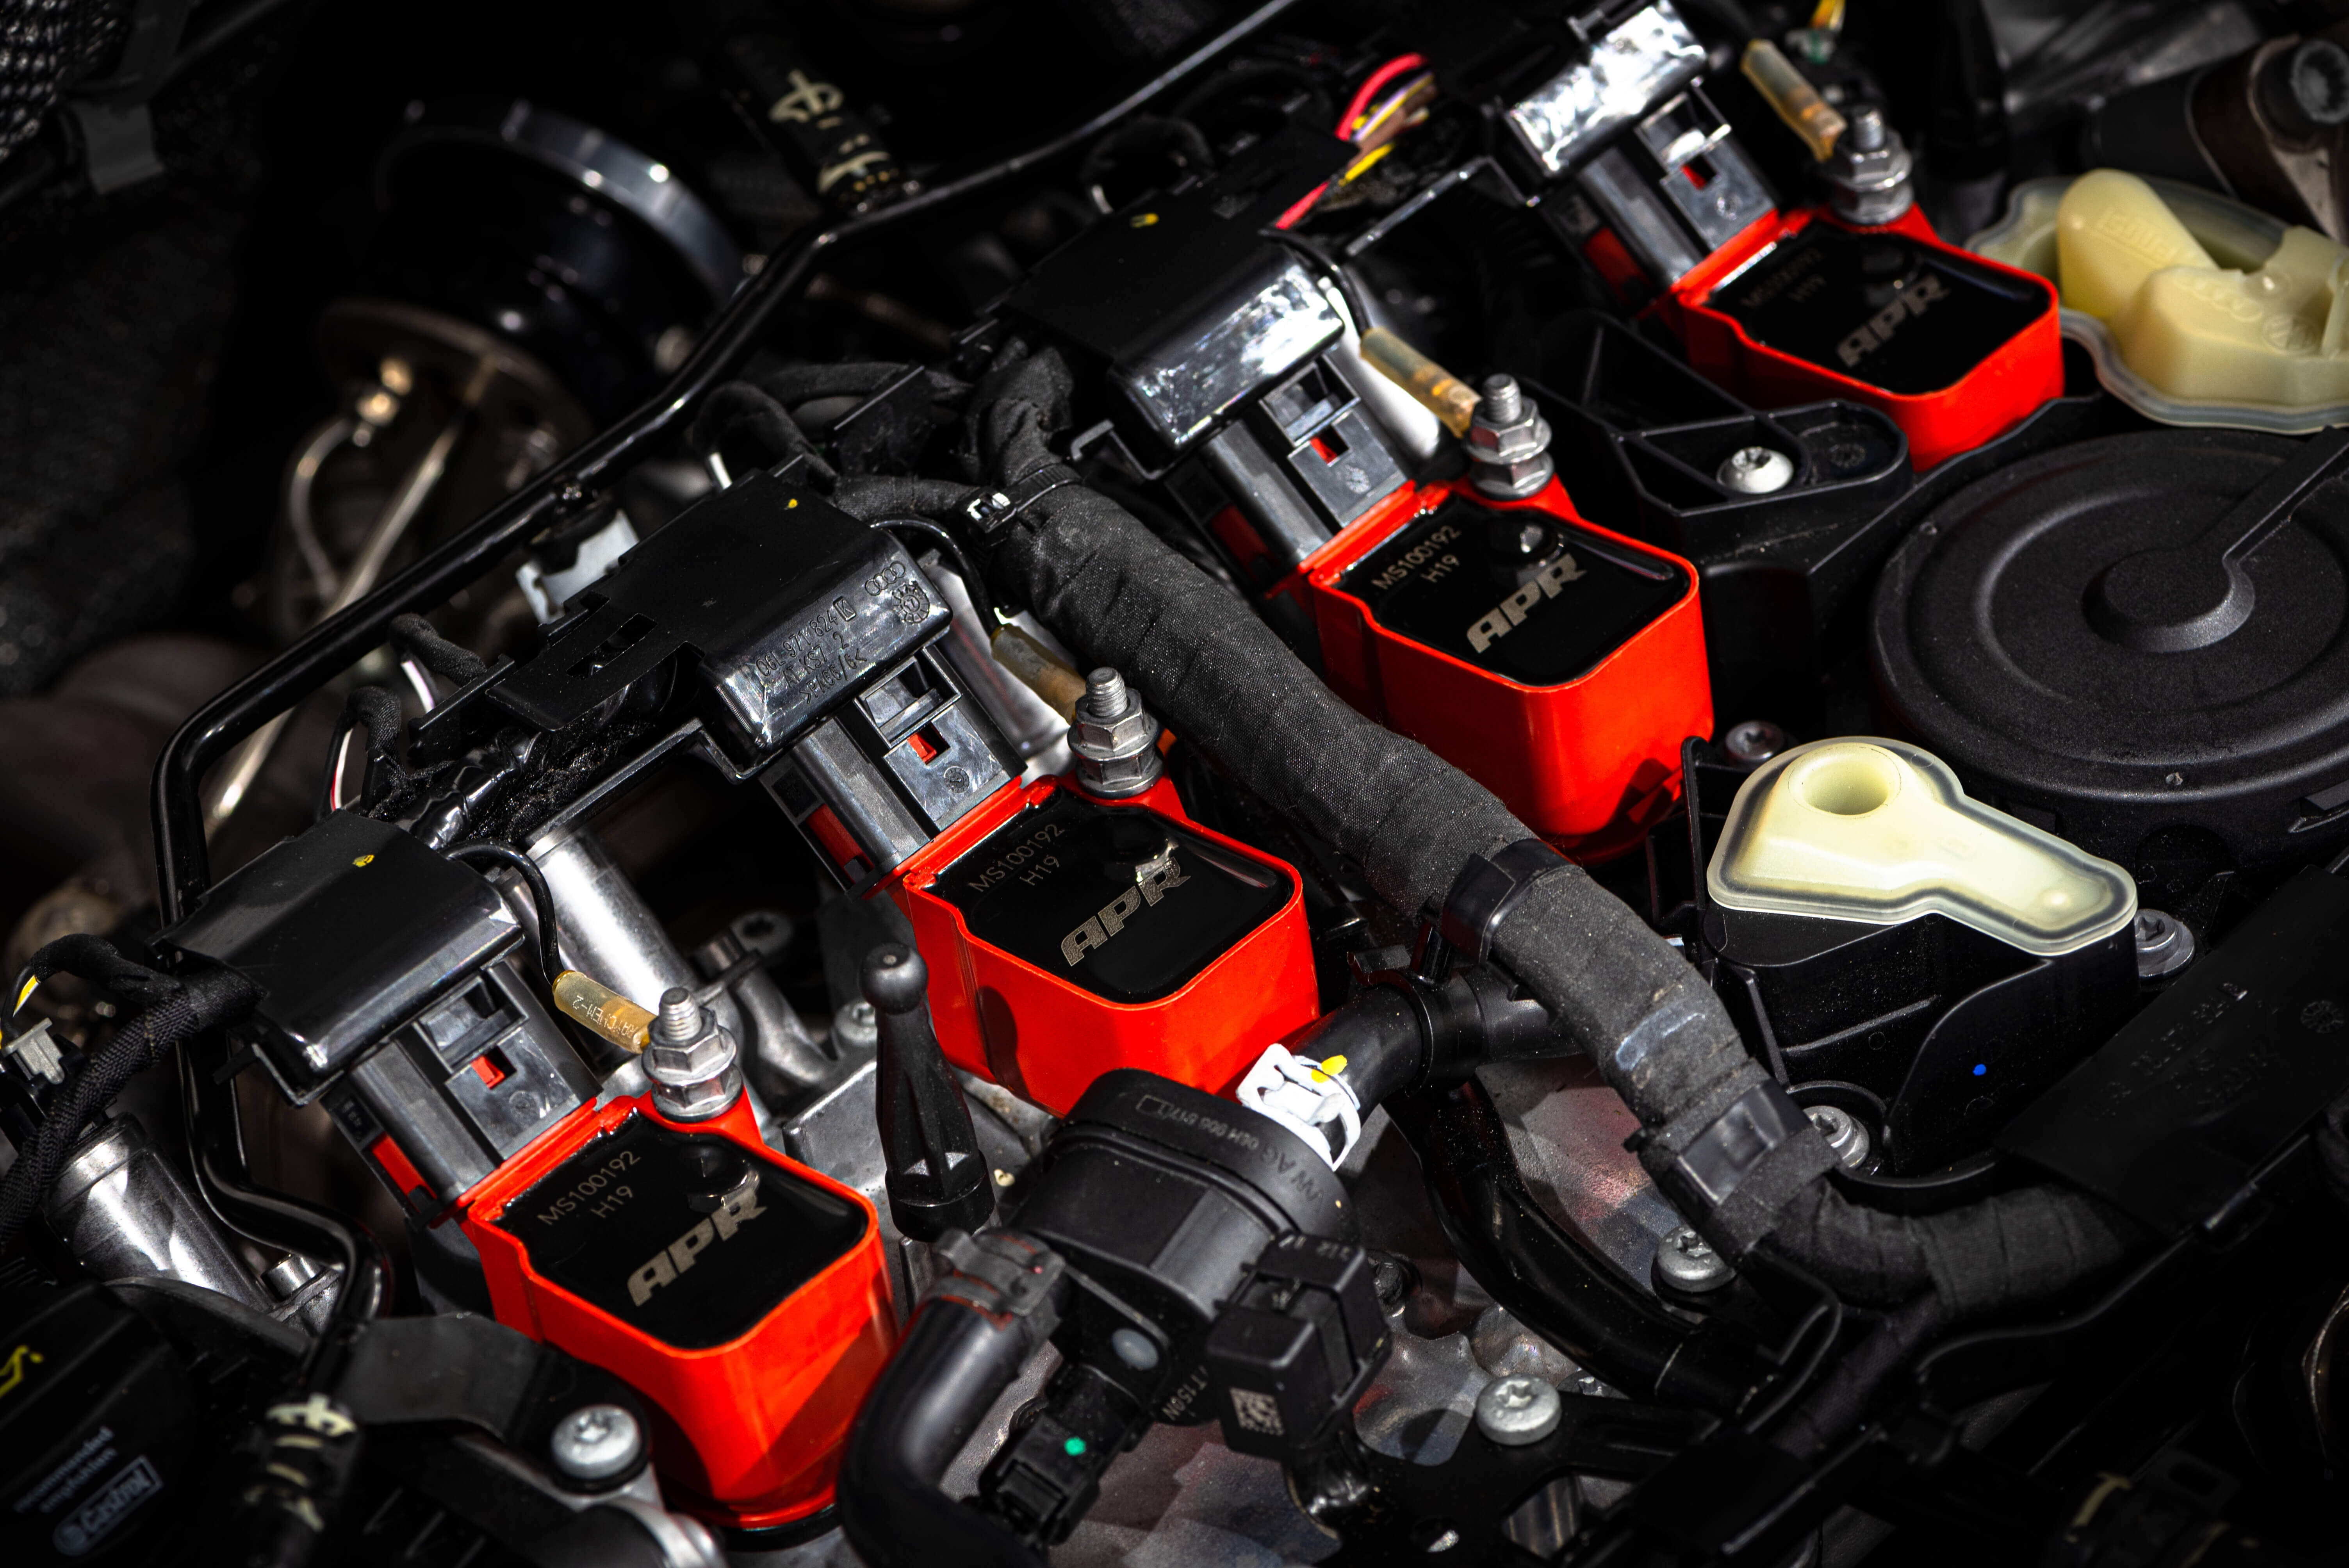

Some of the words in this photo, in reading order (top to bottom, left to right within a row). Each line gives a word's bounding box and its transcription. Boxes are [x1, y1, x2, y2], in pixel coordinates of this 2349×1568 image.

[1837, 274, 1951, 367] APR
[1371, 526, 1462, 590] MS100192
[1420, 554, 1460, 583] H19
[1467, 553, 1587, 654] APR
[756, 651, 786, 677] 06L
[783, 631, 811, 657] 971
[809, 610, 838, 636] 824
[969, 824, 1065, 893] MS100192
[1019, 856, 1060, 886] H19
[1061, 858, 1191, 966] APR
[537, 1151, 641, 1225] MS100192
[590, 1186, 634, 1218] H19
[627, 1188, 767, 1307] APR
[78, 1467, 151, 1534] Castrol
